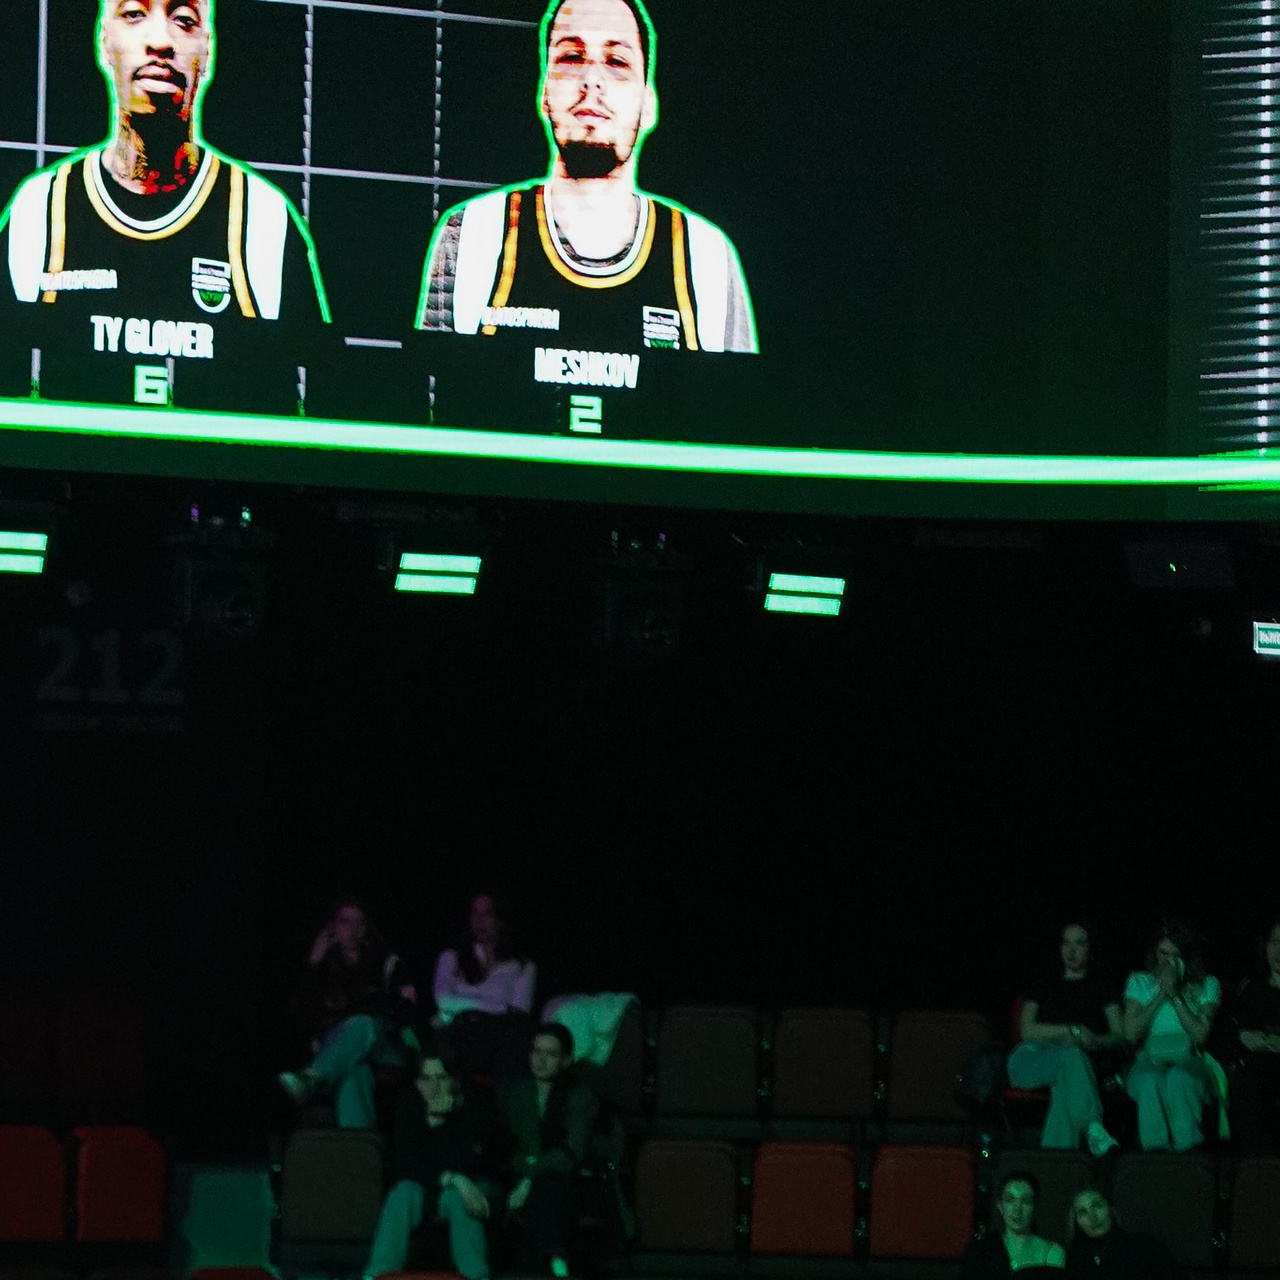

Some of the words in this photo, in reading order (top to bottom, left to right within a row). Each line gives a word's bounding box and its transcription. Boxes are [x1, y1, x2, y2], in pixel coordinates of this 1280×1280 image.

[90, 316, 123, 352] TY
[124, 318, 214, 359] GLOVER
[134, 365, 167, 404] 6
[534, 347, 640, 389] MESHKOV
[570, 395, 602, 433] 2
[34, 626, 185, 704] 212
